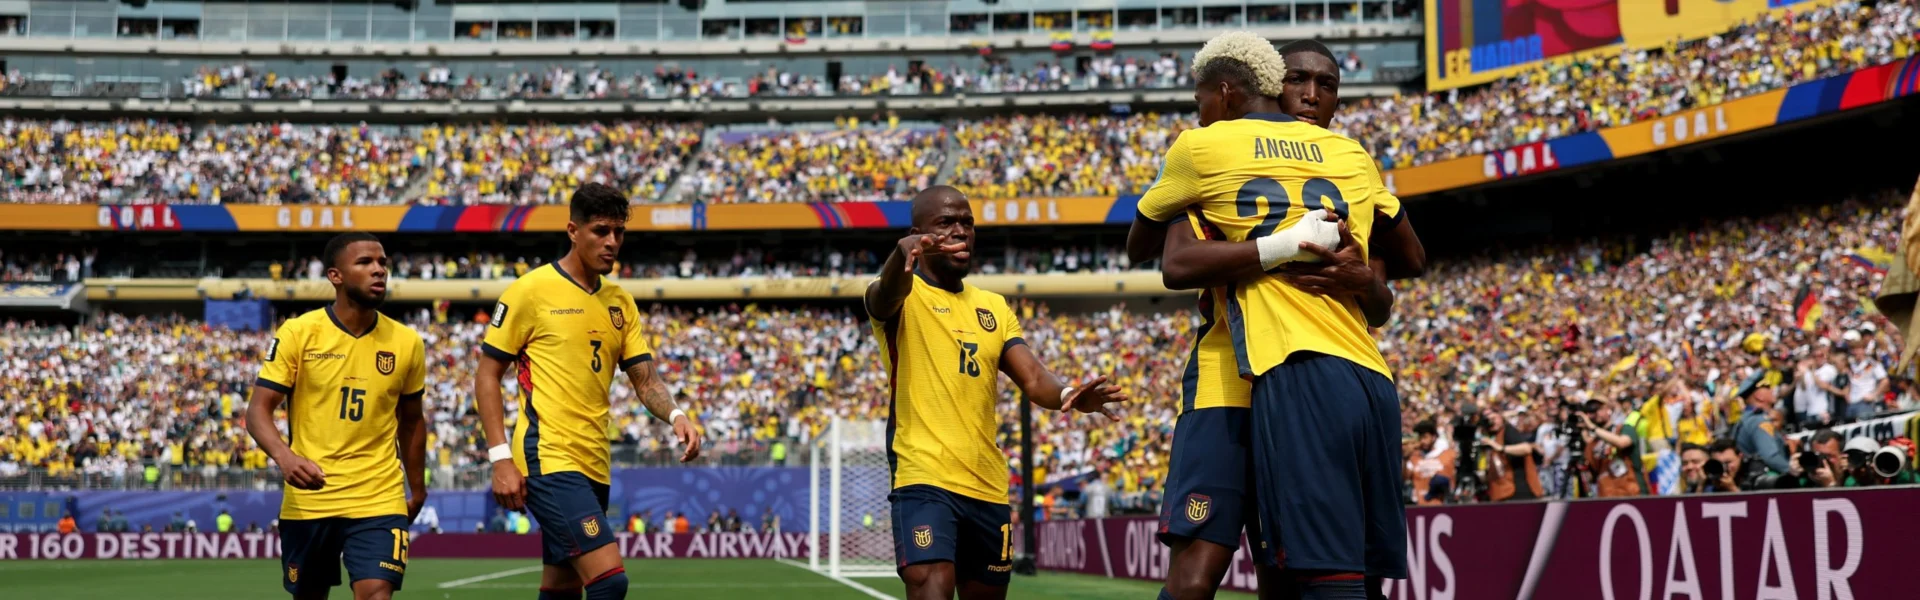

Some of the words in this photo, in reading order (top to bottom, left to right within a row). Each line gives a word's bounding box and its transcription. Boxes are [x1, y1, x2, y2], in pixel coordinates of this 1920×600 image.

[1653, 107, 1728, 145] GOAL
[1254, 137, 1324, 164] ANGULO
[1484, 142, 1554, 178] GOAL
[97, 205, 175, 228] GOAL
[277, 206, 354, 228] GOAL
[983, 200, 1059, 222] GOAL
[550, 307, 585, 315] marathon
[308, 351, 346, 360] marathon
[590, 340, 602, 374] 3
[957, 338, 980, 378] 13
[340, 386, 366, 422] 15
[30, 533, 84, 559] 160
[614, 532, 673, 557] TAR
[1600, 497, 1864, 600] QATAR
